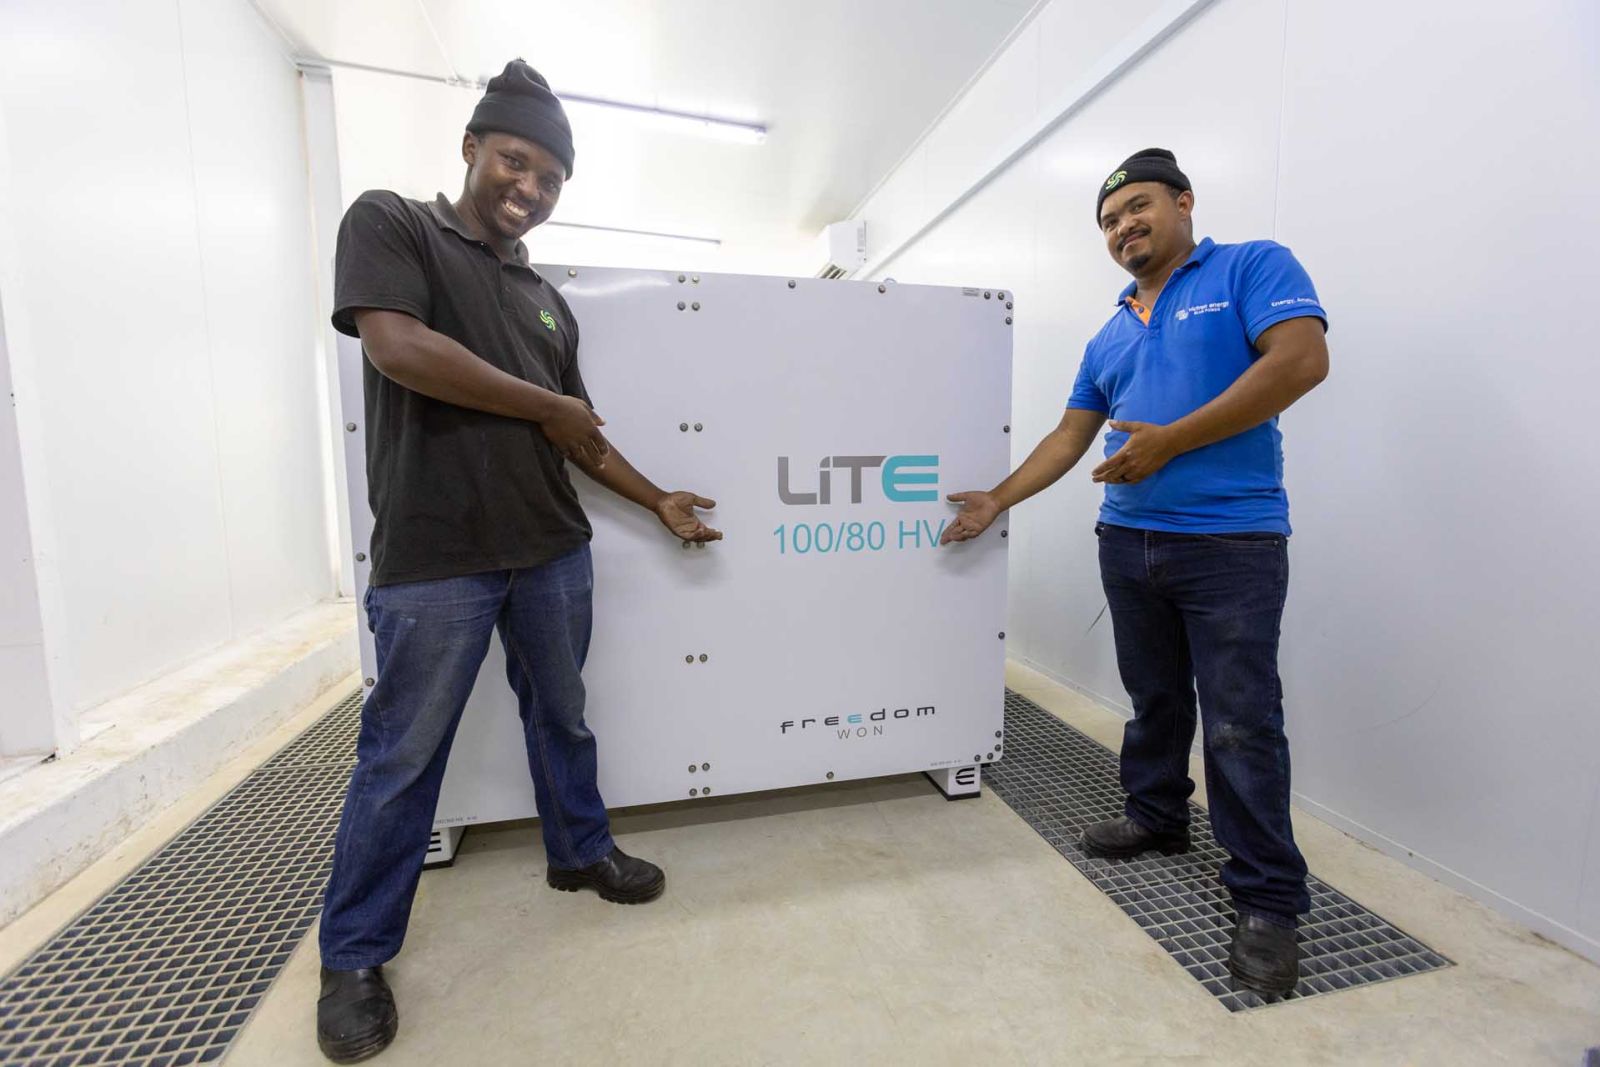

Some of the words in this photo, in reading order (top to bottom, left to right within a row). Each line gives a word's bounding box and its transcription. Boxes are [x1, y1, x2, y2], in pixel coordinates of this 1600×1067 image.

[773, 521, 886, 554] 100/80
[898, 519, 946, 549] HV
[837, 725, 884, 739] WON
